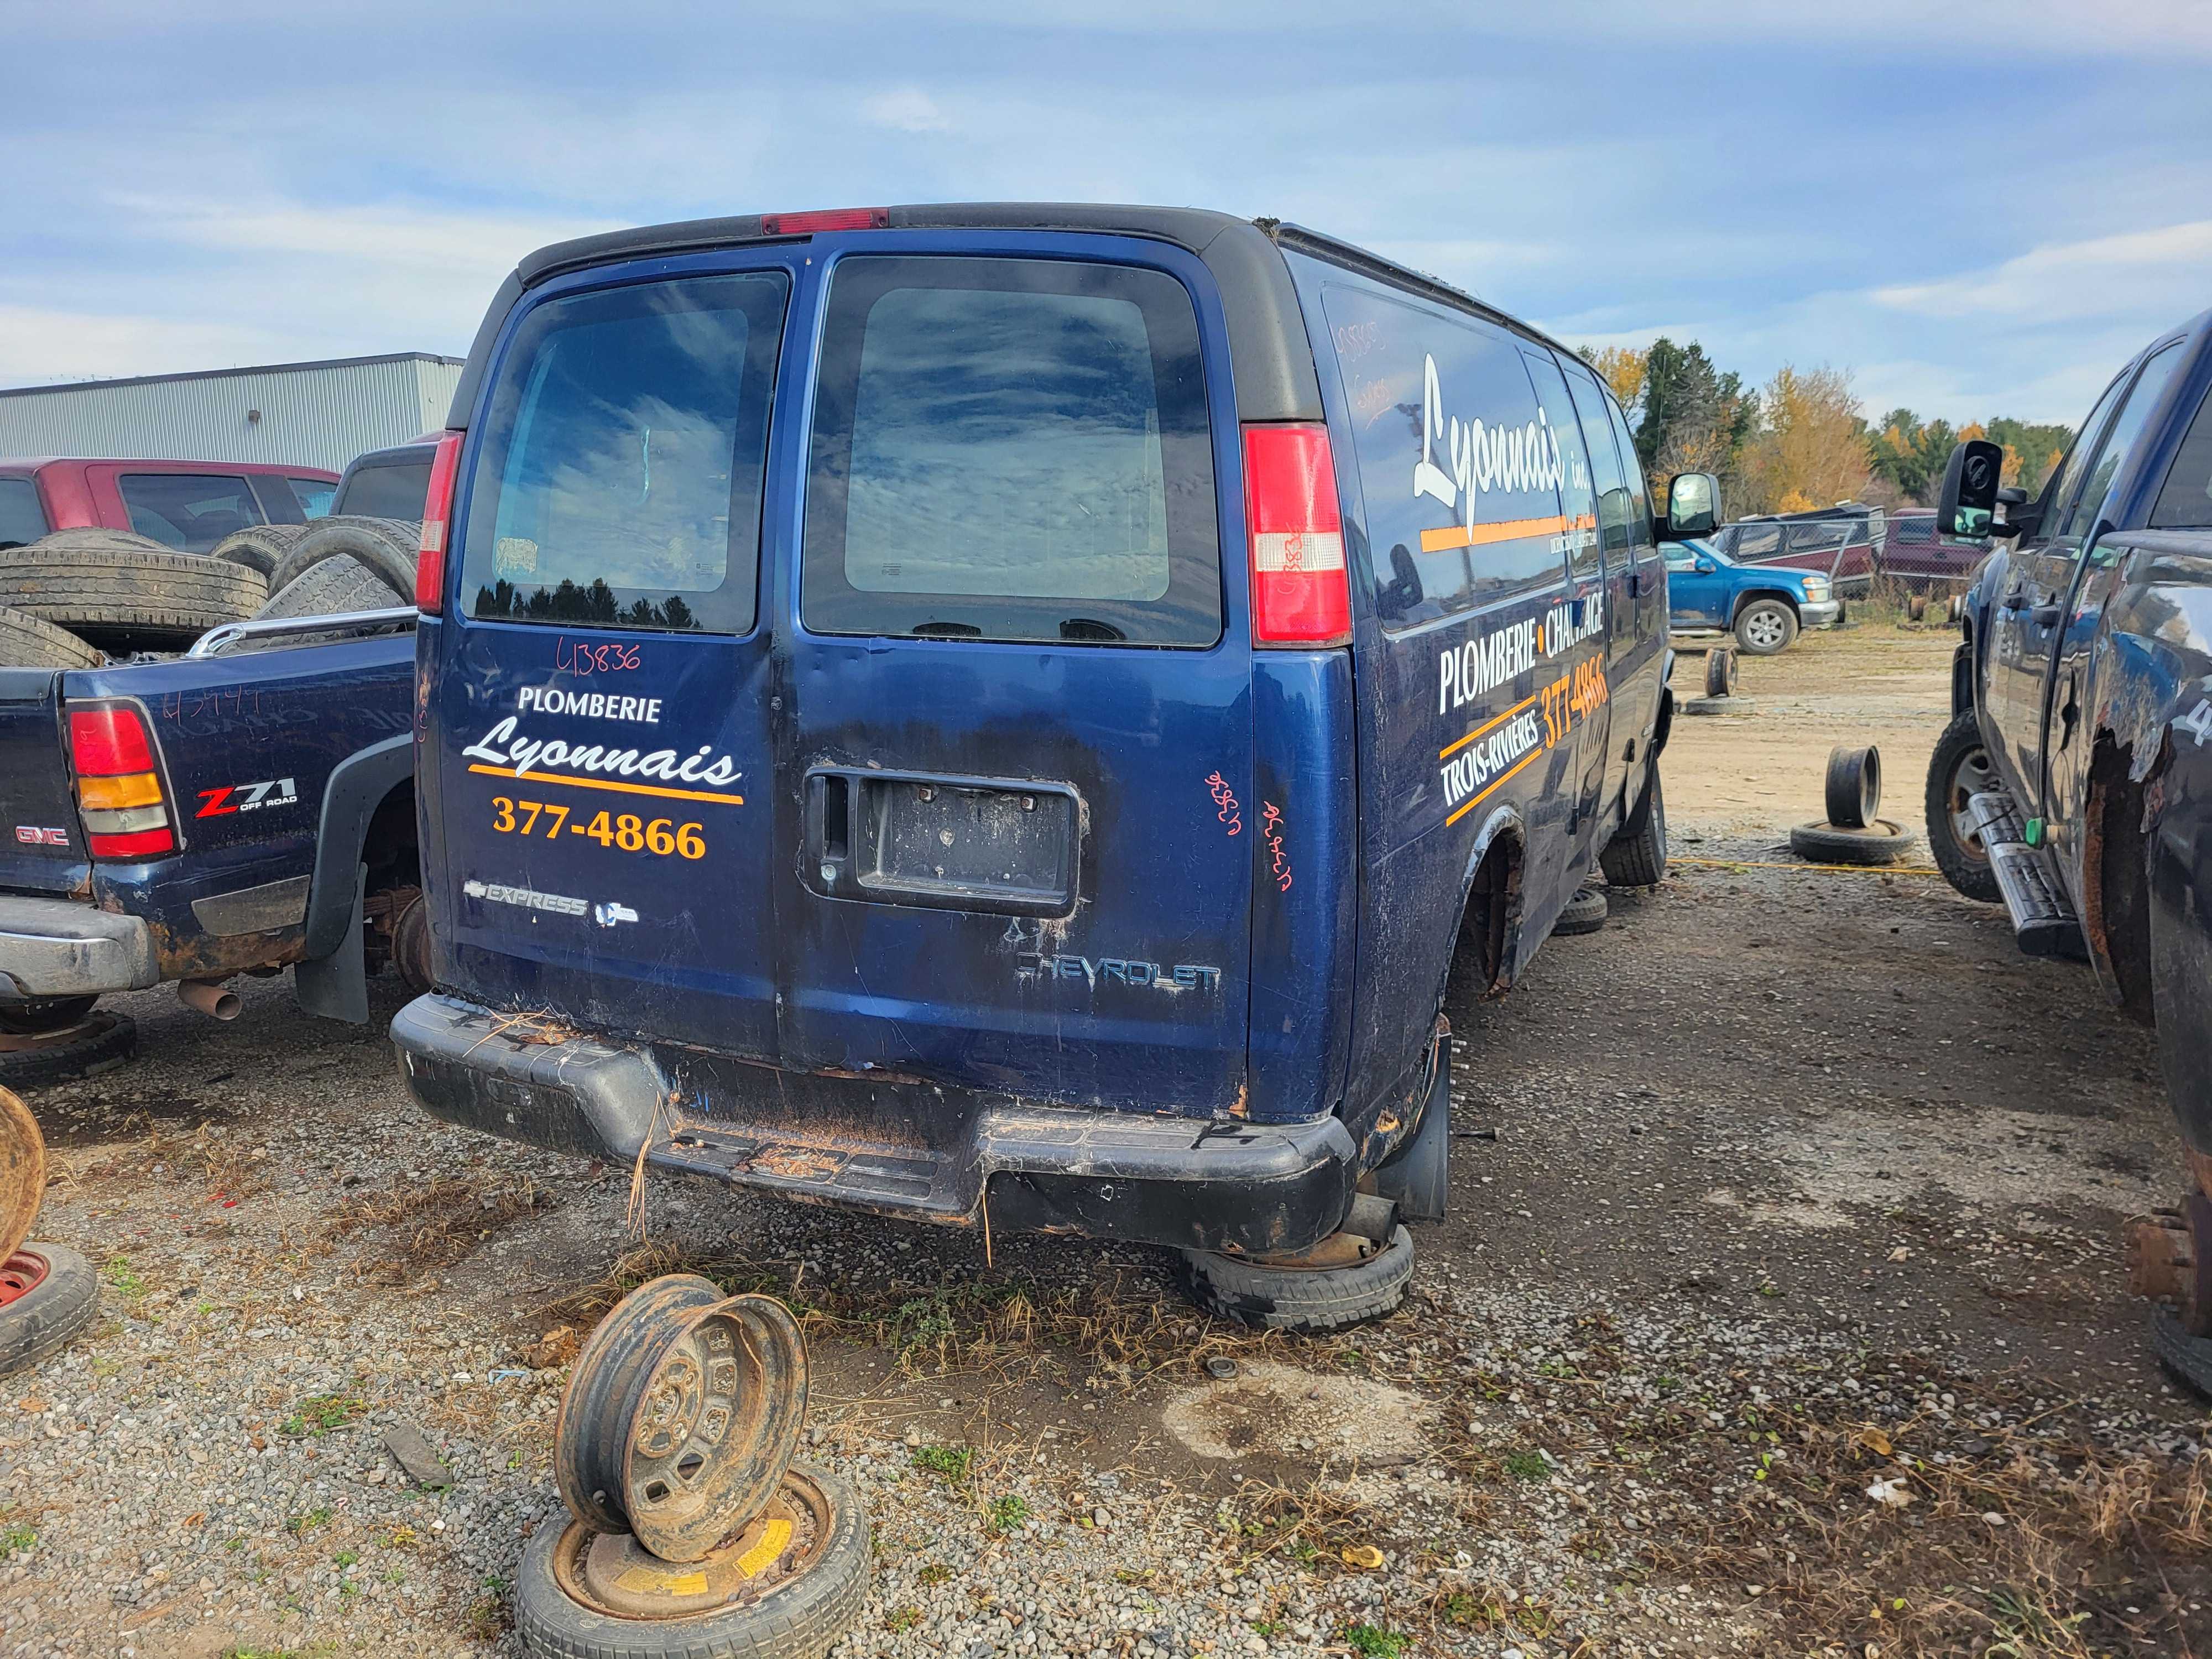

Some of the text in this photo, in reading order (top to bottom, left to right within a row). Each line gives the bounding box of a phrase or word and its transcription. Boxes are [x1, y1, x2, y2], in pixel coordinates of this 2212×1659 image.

[1413, 352, 1566, 545] Lyonnais
[1440, 617, 1536, 715] PLOMBERIE
[518, 687, 662, 723] PLOMBERIE
[1541, 652, 1608, 749] 377-4866
[462, 716, 742, 785] Lyonnais
[1440, 708, 1538, 807] TROIS-RIVIÈRES
[194, 777, 296, 818] Z71
[240, 795, 298, 811] OFF ROAD
[15, 826, 70, 846] GMC
[492, 797, 706, 860] 377-4866
[486, 884, 588, 916] EXPRESS
[1016, 952, 1221, 988] CHEVROLET
